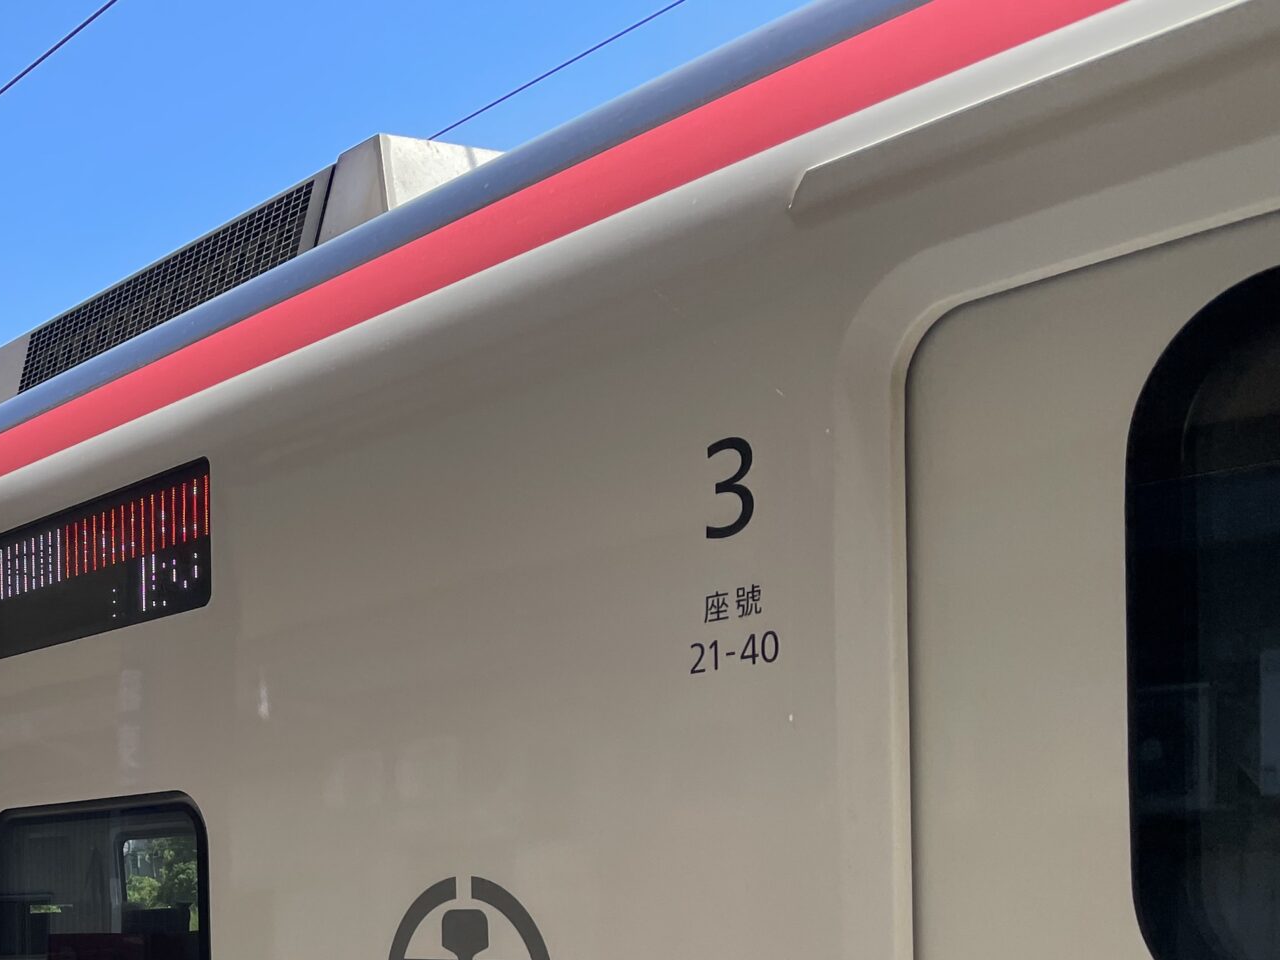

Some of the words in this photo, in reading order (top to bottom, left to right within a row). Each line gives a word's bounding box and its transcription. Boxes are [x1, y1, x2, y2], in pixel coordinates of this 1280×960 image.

[706, 436, 754, 539] 3
[704, 583, 762, 623] 座號
[689, 630, 780, 675] 21-40
